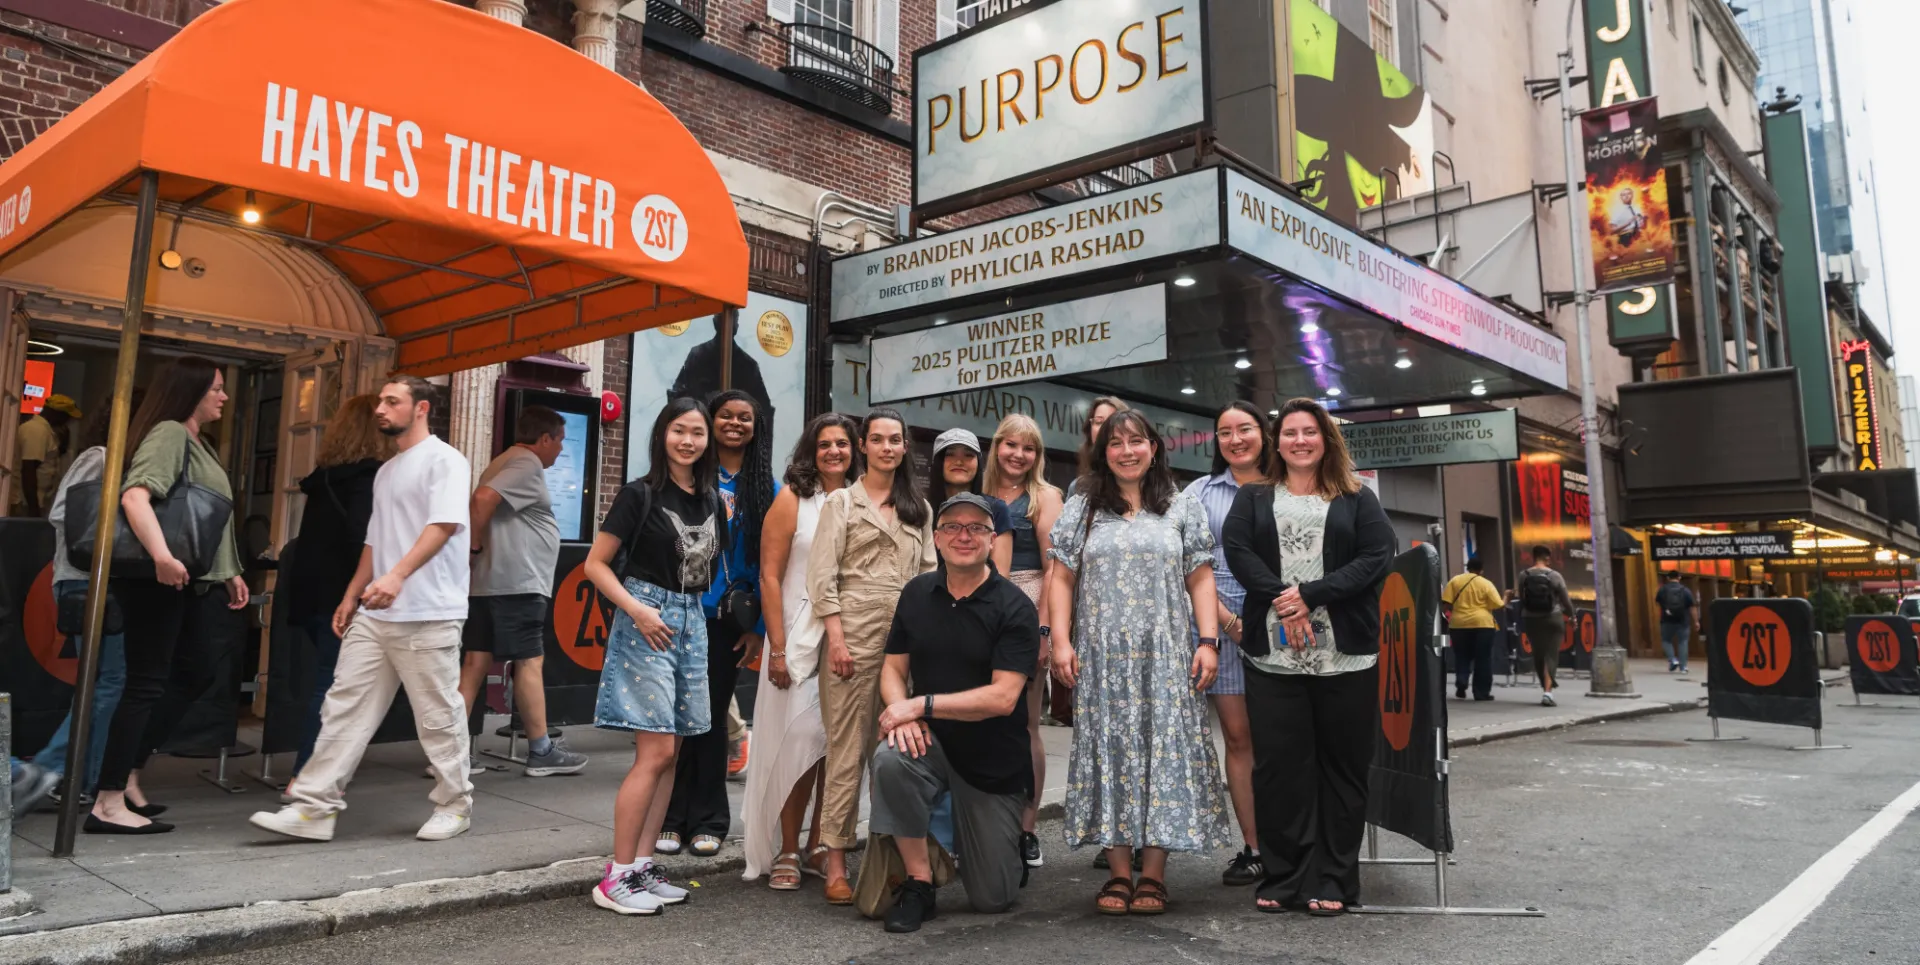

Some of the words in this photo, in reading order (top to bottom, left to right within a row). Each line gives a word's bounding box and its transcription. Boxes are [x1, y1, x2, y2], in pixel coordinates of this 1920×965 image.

[927, 6, 1189, 156] PURPOSE
[261, 81, 423, 198] HAYES
[445, 133, 617, 249] THEATER
[1587, 134, 1658, 162] MORMN
[643, 206, 678, 252] 2ST
[867, 263, 880, 276] BY
[883, 236, 974, 276] BRANDEN
[980, 191, 1164, 253] JACOBS-JENKINS
[879, 279, 929, 299] DIRECTED
[931, 275, 946, 288] BY
[950, 250, 1044, 288] PHYLICIA
[1051, 228, 1145, 267] RASHAD
[1270, 205, 1355, 270] EXPLOSIVE,
[1358, 249, 1429, 304] BLISTERING
[1431, 287, 1502, 337] STEPPENWOLF
[967, 312, 1044, 343] WINNER
[1409, 304, 1434, 325] CHICAGO
[911, 350, 952, 373] 2025
[957, 331, 1045, 366] PULITZER
[1051, 321, 1112, 348] PRIZE
[957, 367, 980, 386] for
[986, 353, 1058, 382] DRAMA
[938, 389, 1035, 420] AWARD
[1156, 422, 1187, 453] EST
[1358, 428, 1369, 438] IS
[1371, 422, 1430, 438] BRINGING
[1432, 420, 1448, 432] US
[1451, 418, 1481, 431] INTO
[1412, 430, 1474, 443] BRINGING
[1477, 428, 1494, 440] US
[1849, 364, 1877, 471] PIZZERIA
[1370, 447, 1392, 459] THE
[1564, 489, 1591, 517] SUNS
[1656, 547, 1685, 557] BEST
[1686, 545, 1739, 556] MUSICAL
[1740, 543, 1789, 555] REVIVAL
[1666, 538, 1692, 546] TONY
[1694, 536, 1731, 546] AWARD
[1734, 535, 1776, 545] WINNER
[1383, 607, 1409, 714] 2ST
[1740, 622, 1778, 671] 2ST
[1865, 631, 1891, 662] 2ST
